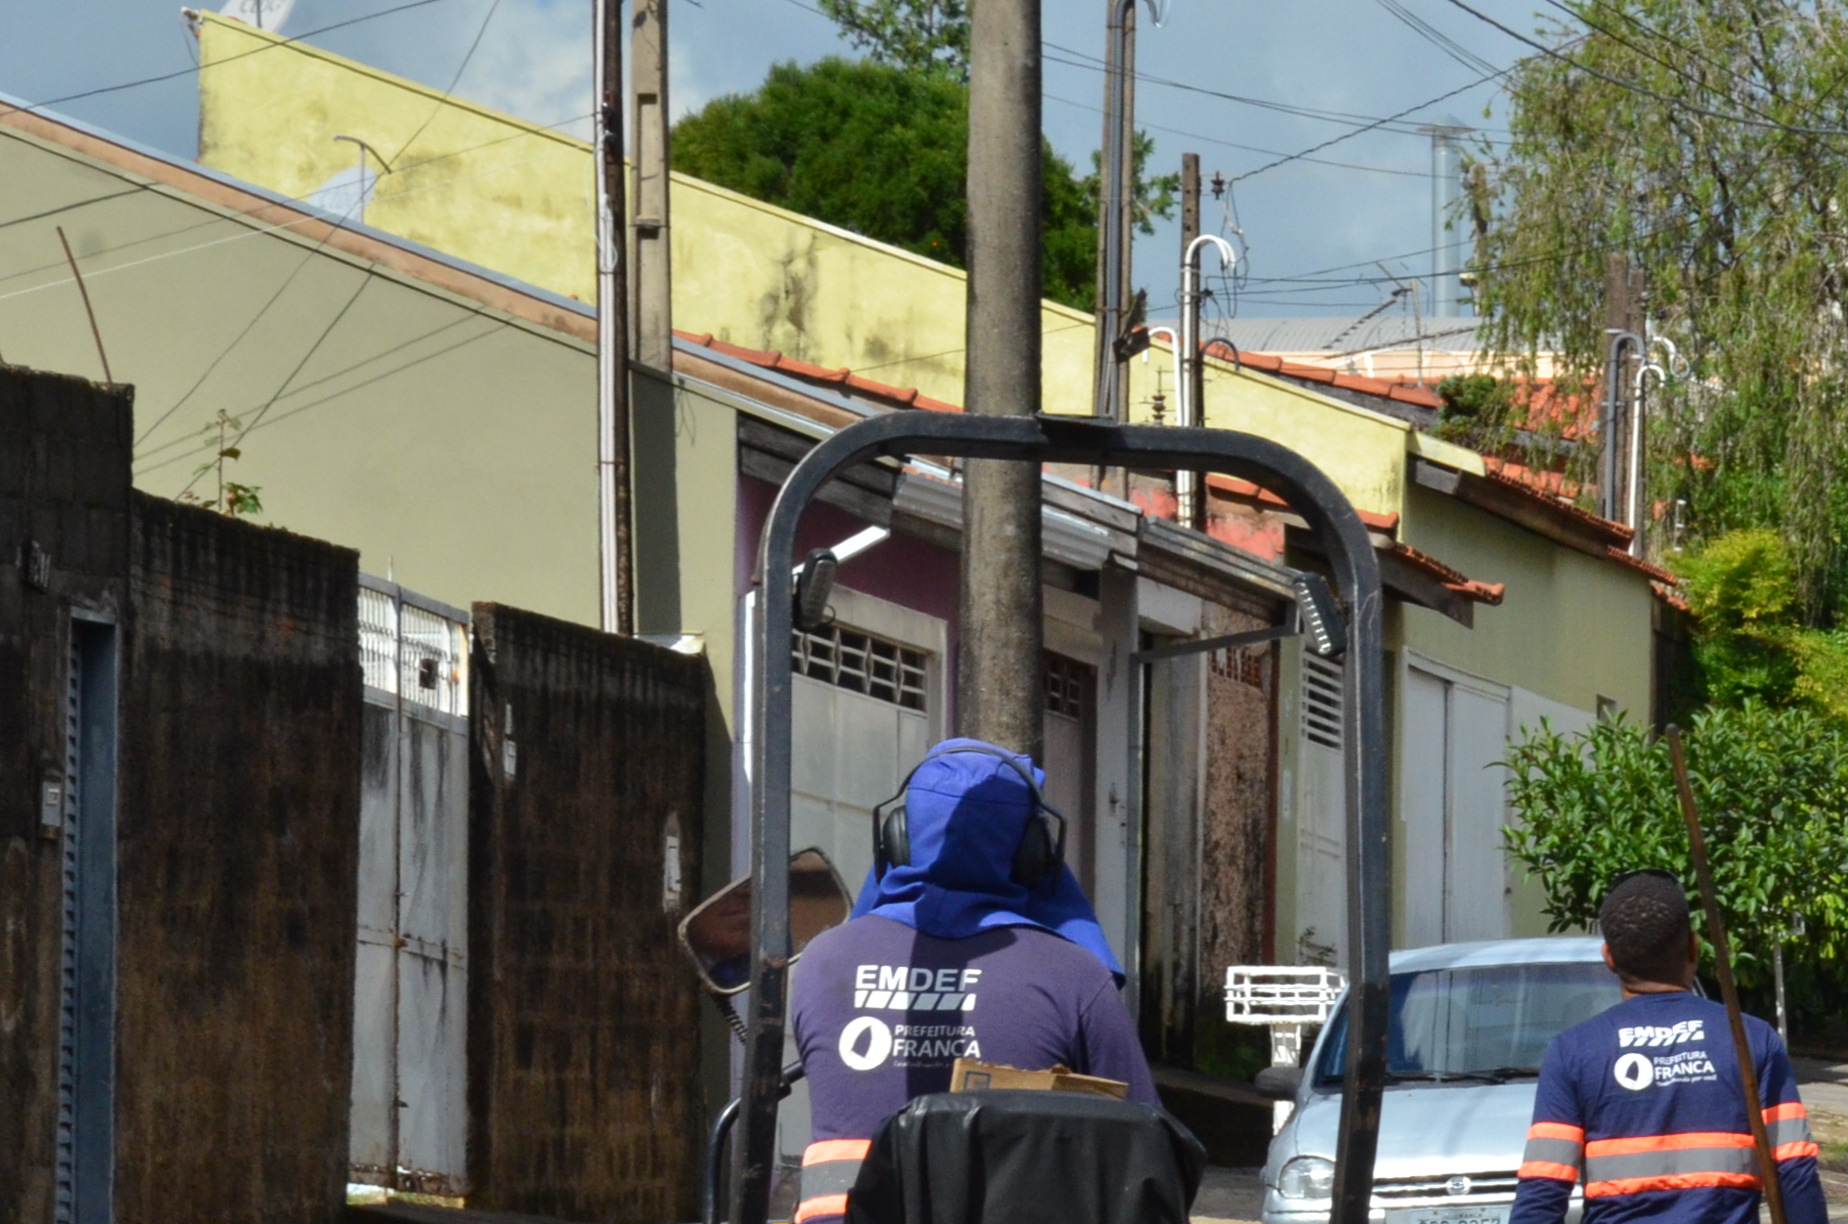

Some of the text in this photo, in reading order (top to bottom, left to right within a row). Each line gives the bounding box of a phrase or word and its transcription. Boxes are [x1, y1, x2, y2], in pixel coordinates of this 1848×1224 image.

[855, 964, 983, 992] EMDEF
[894, 1024, 976, 1037] PREFEITURA
[1618, 1019, 1704, 1039] EMDEF
[892, 1039, 981, 1059] FRANCA
[1653, 1050, 1708, 1066] PREFEITURA
[1654, 1060, 1716, 1080] FRANCA
